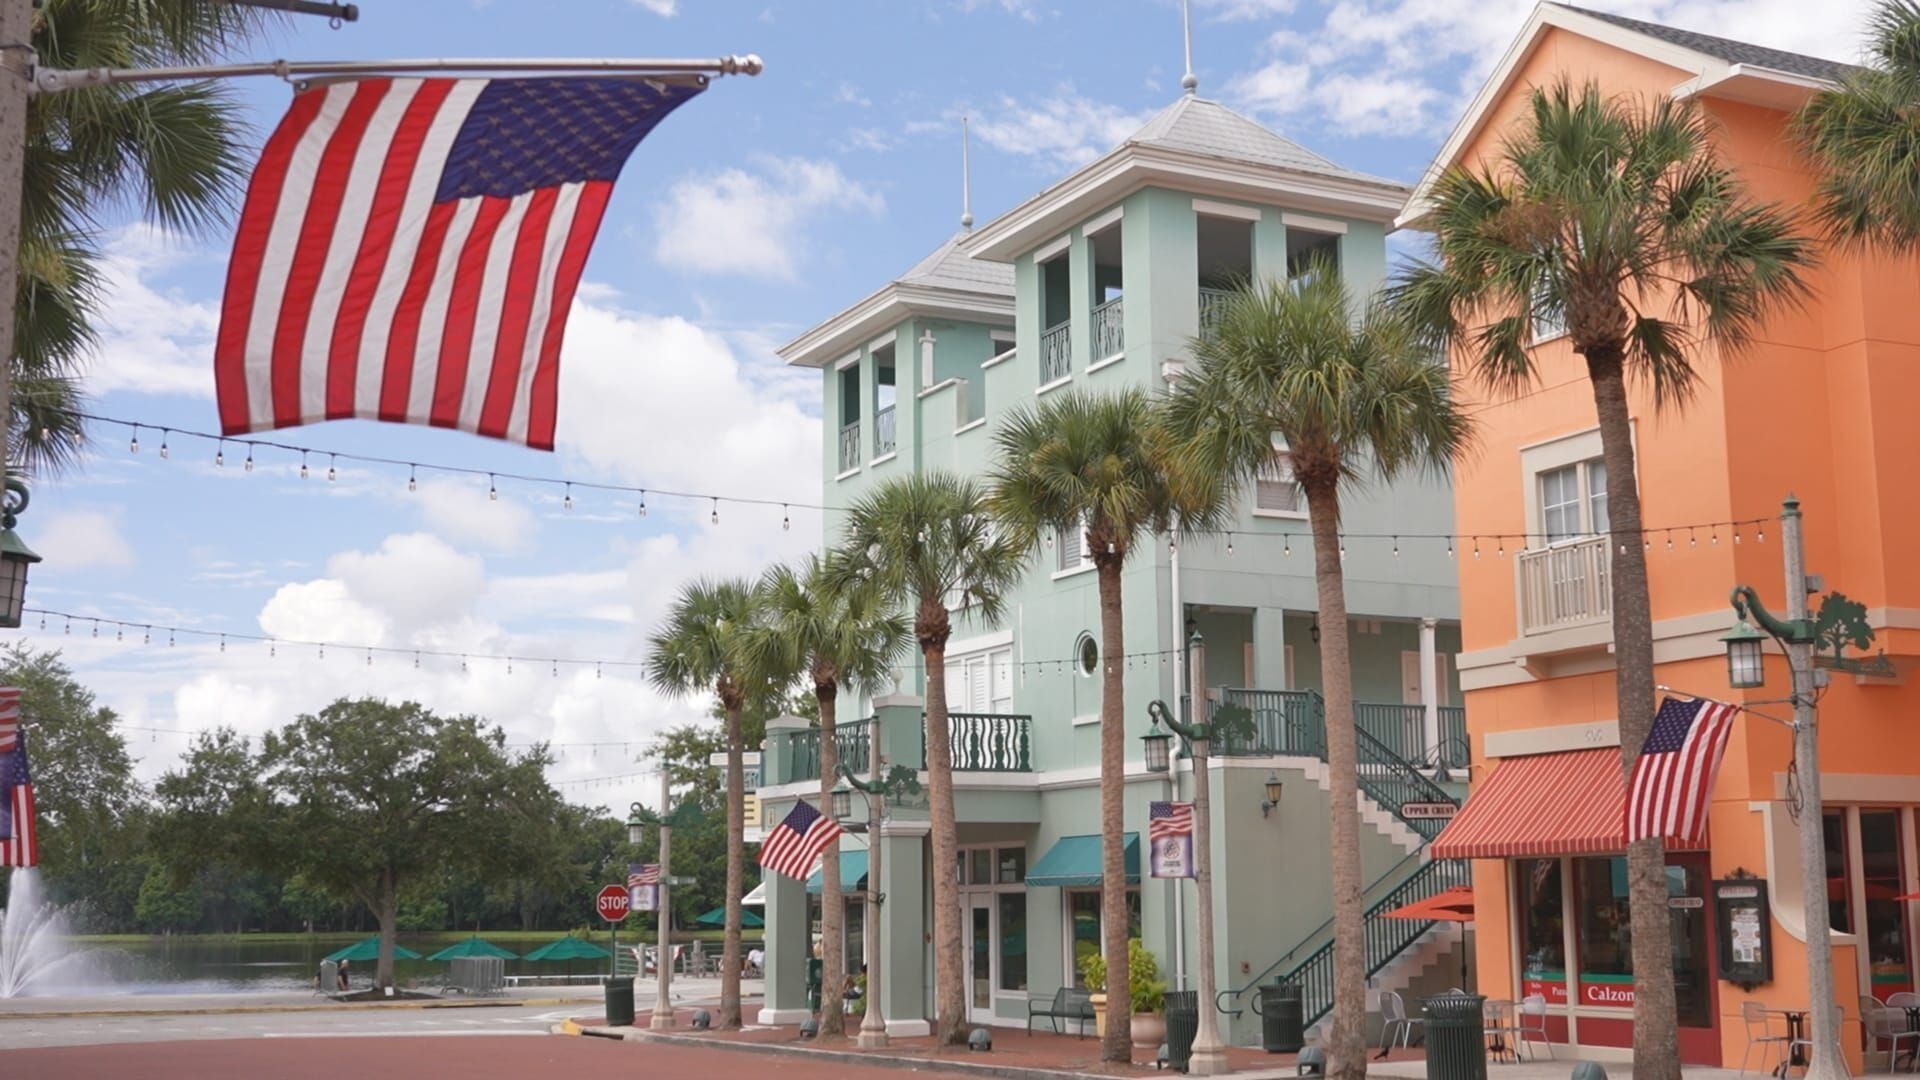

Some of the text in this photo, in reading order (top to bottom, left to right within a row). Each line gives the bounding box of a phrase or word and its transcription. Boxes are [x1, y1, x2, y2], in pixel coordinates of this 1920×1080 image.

[1404, 806, 1454, 815] UPPER CRUST
[600, 895, 629, 910] STOP
[1587, 985, 1635, 1001] Calzon
